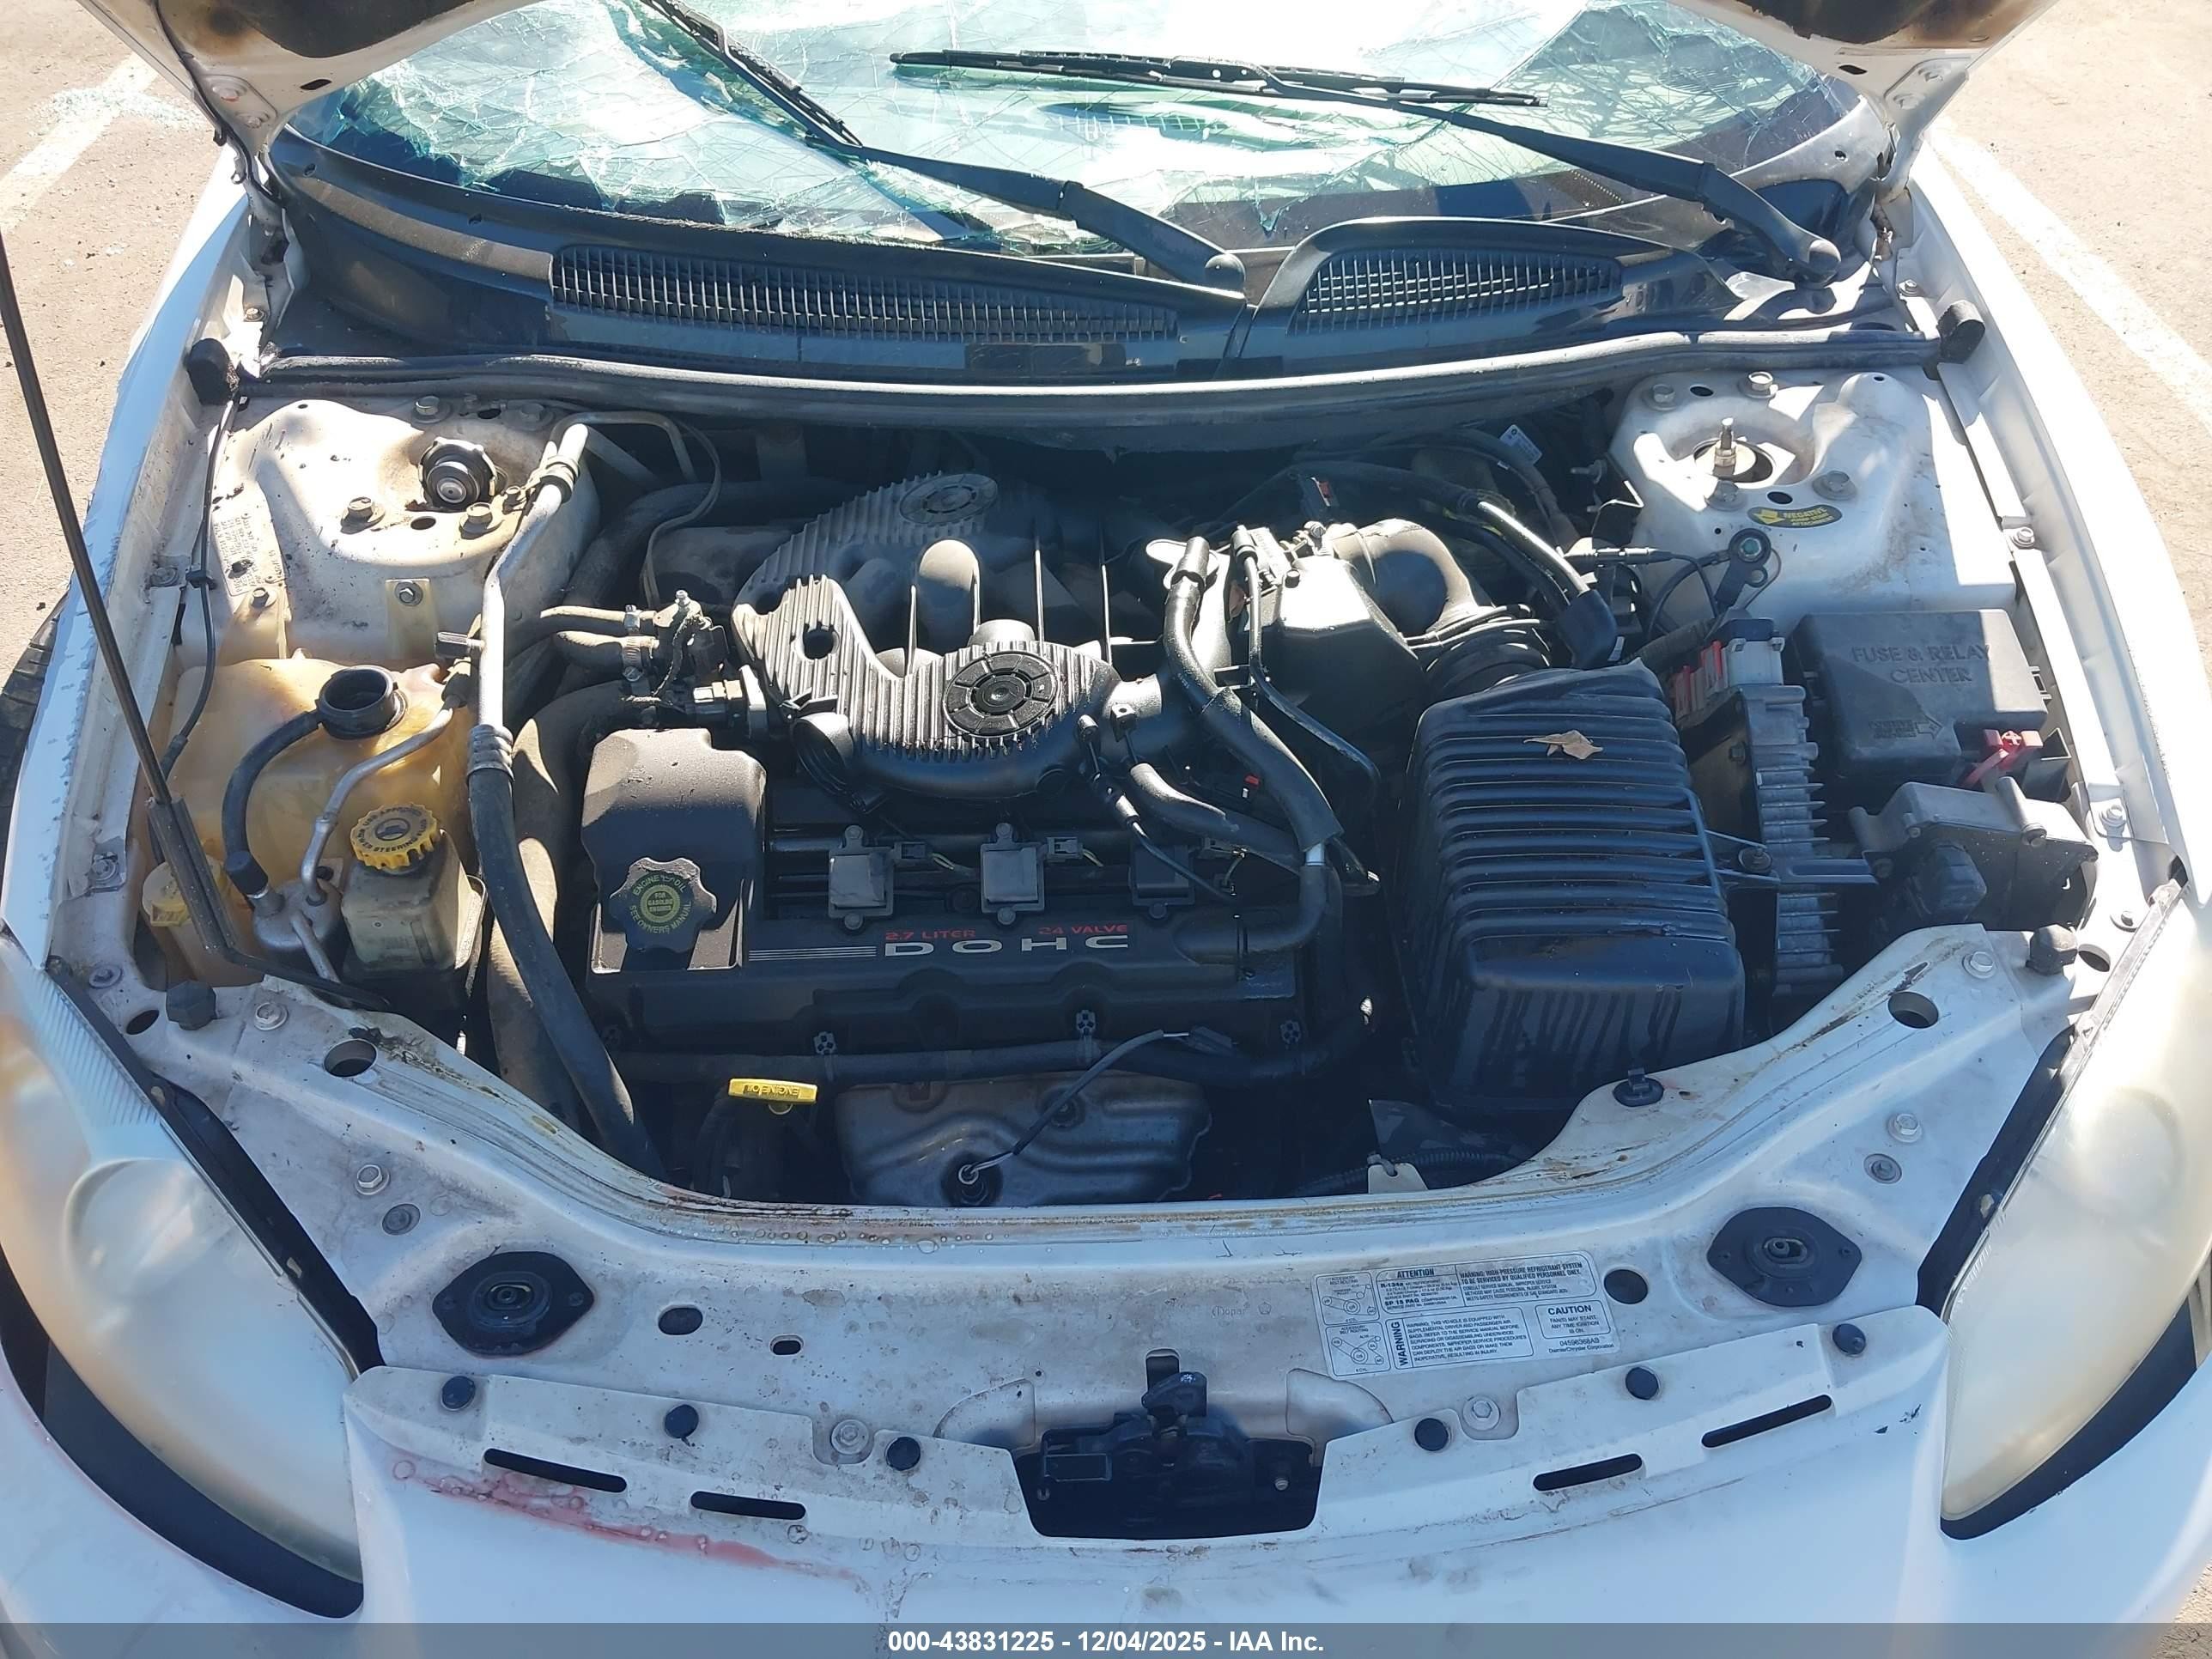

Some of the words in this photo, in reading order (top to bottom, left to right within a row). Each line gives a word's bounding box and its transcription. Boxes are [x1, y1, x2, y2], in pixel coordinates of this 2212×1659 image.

[1784, 507, 1827, 518] NEGATIVE
[1851, 646, 1903, 662] FUSE
[1928, 644, 1990, 661] RELAY
[1891, 667, 1972, 684] CENTER
[374, 838, 418, 852] STEERING
[633, 874, 660, 896] ENGINE
[674, 878, 687, 893] OIL
[629, 905, 641, 921] SEE
[670, 901, 692, 929] MANUAL
[885, 932, 915, 940] 2.7
[921, 929, 976, 940] LITER
[1071, 924, 1127, 934] VALVE
[1397, 1268, 1435, 1279] ATTENTION
[1527, 1264, 1561, 1273] REFRIGERANT
[1563, 1261, 1583, 1270] SYSTEM
[1477, 1275, 1501, 1284] SERVICED
[1510, 1272, 1536, 1280] QUALIFIED
[1537, 1269, 1566, 1279] PERSONNEL
[1548, 1305, 1591, 1315] CAUTION
[1391, 1322, 1409, 1367] WARNING
